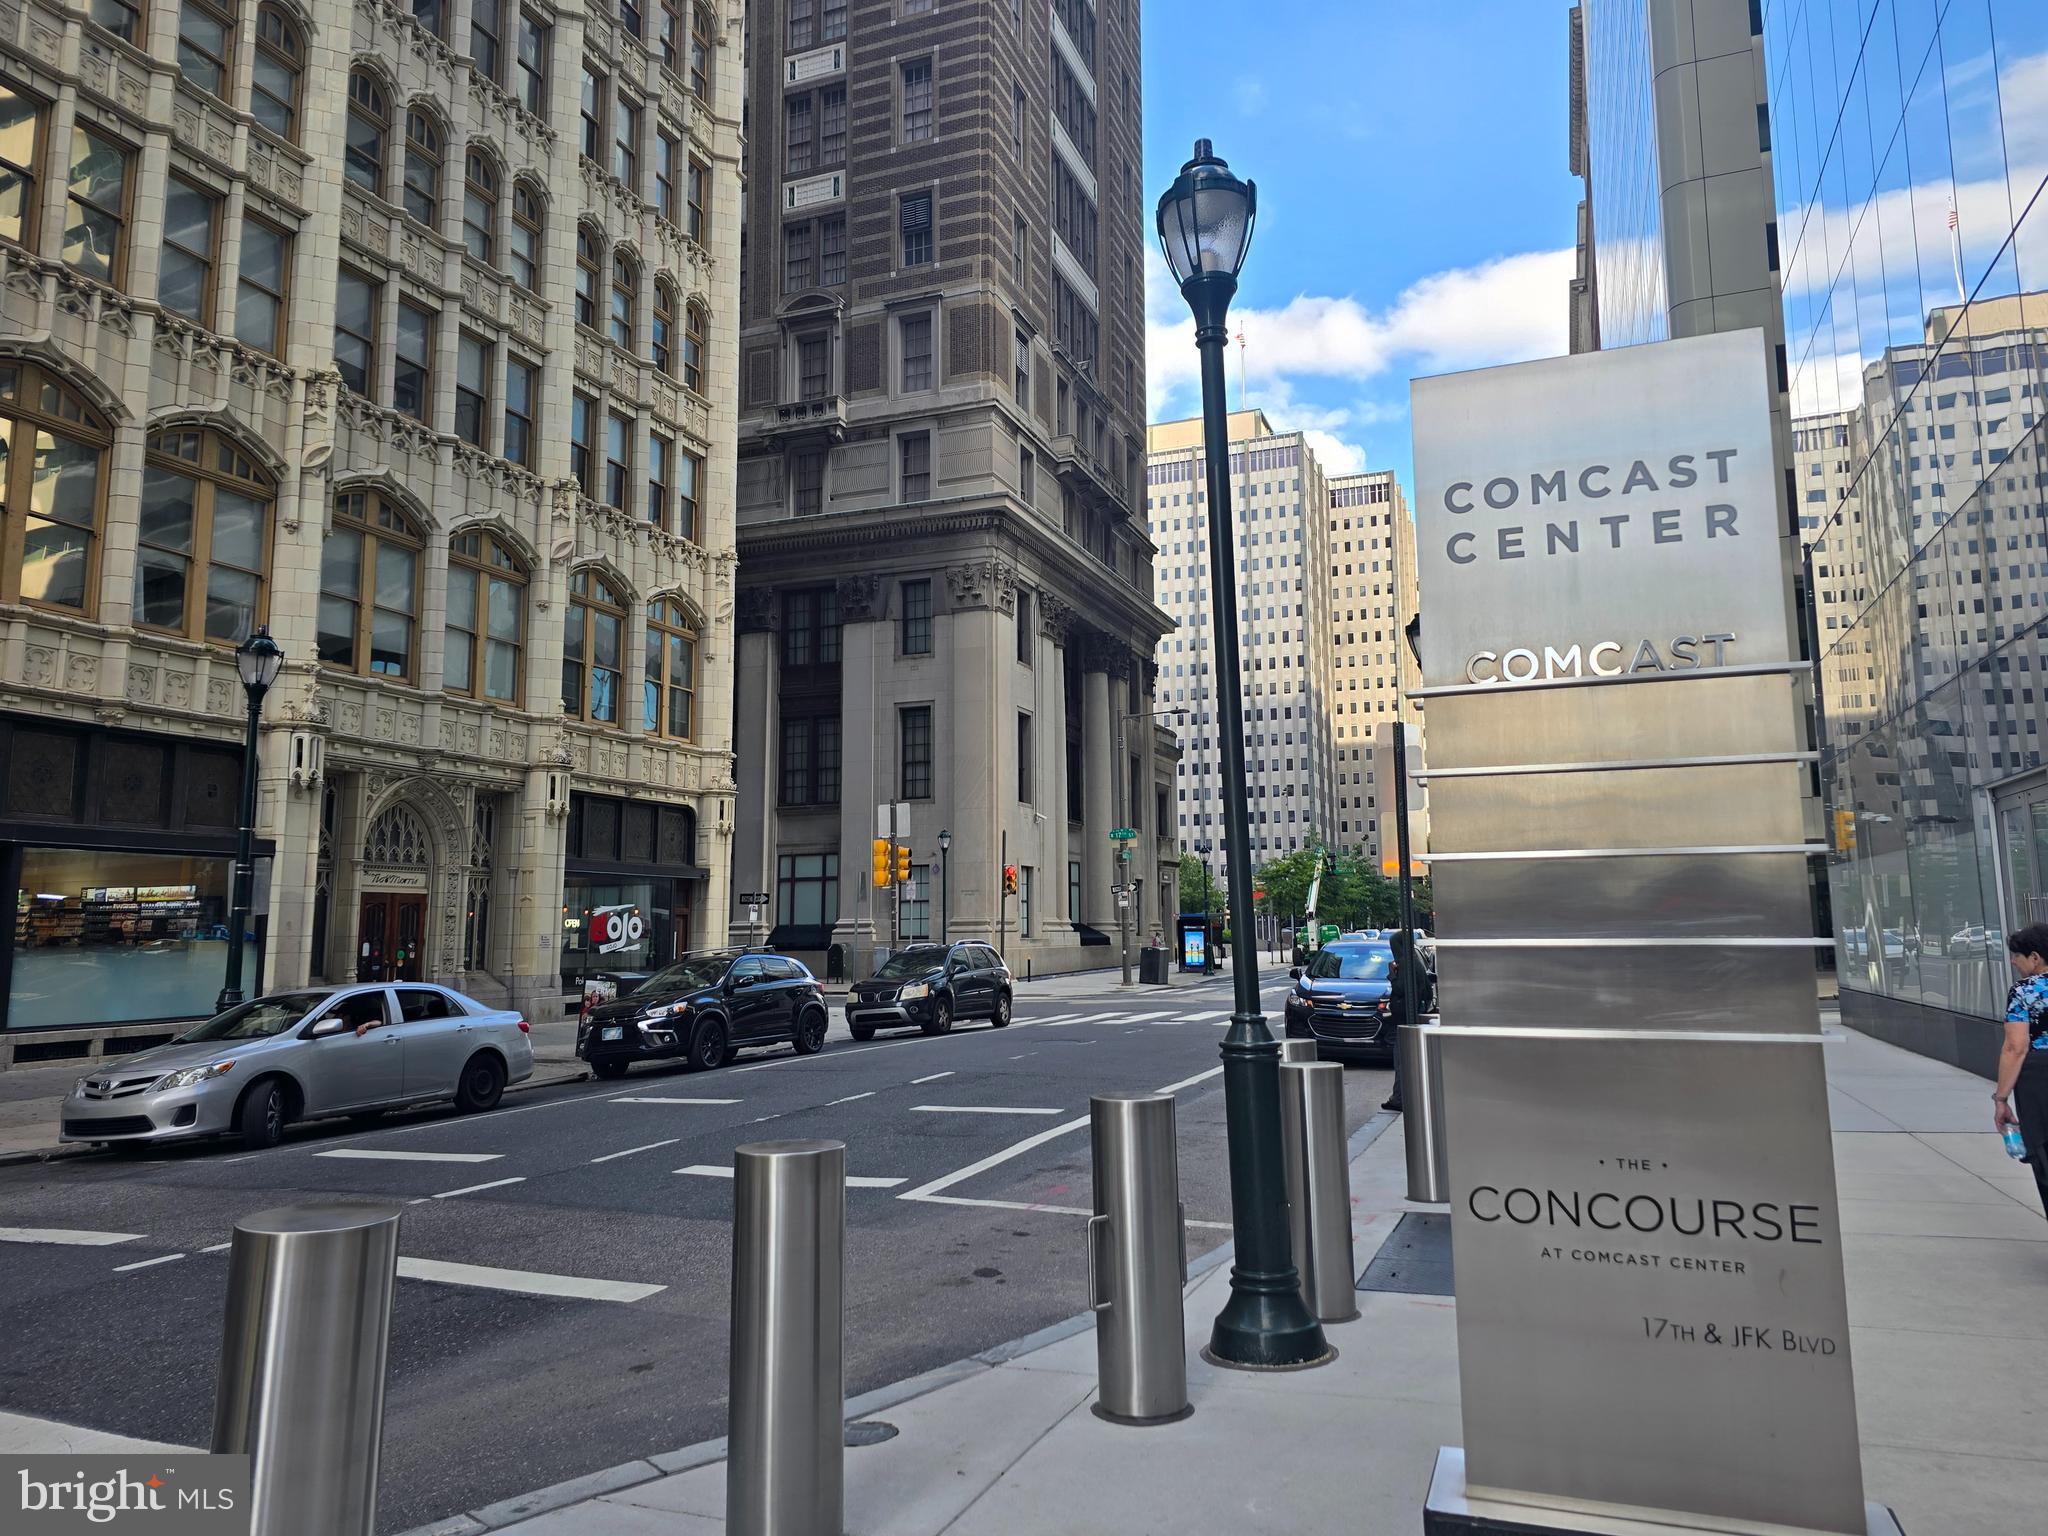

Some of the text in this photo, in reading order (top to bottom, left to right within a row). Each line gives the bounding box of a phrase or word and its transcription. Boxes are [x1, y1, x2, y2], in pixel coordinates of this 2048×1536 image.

[1443, 448, 1738, 514] COMCAST
[1446, 504, 1740, 564] CENTER
[1465, 632, 1736, 684] COMCAST
[1616, 1157, 1651, 1171] THE
[1468, 1185, 1823, 1244] CONCOURSE
[1540, 1246, 1746, 1275] AT COMCAST CENTER
[1642, 1316, 1695, 1342] 17TH
[1704, 1322, 1722, 1345] &
[1731, 1325, 1772, 1350] JFK
